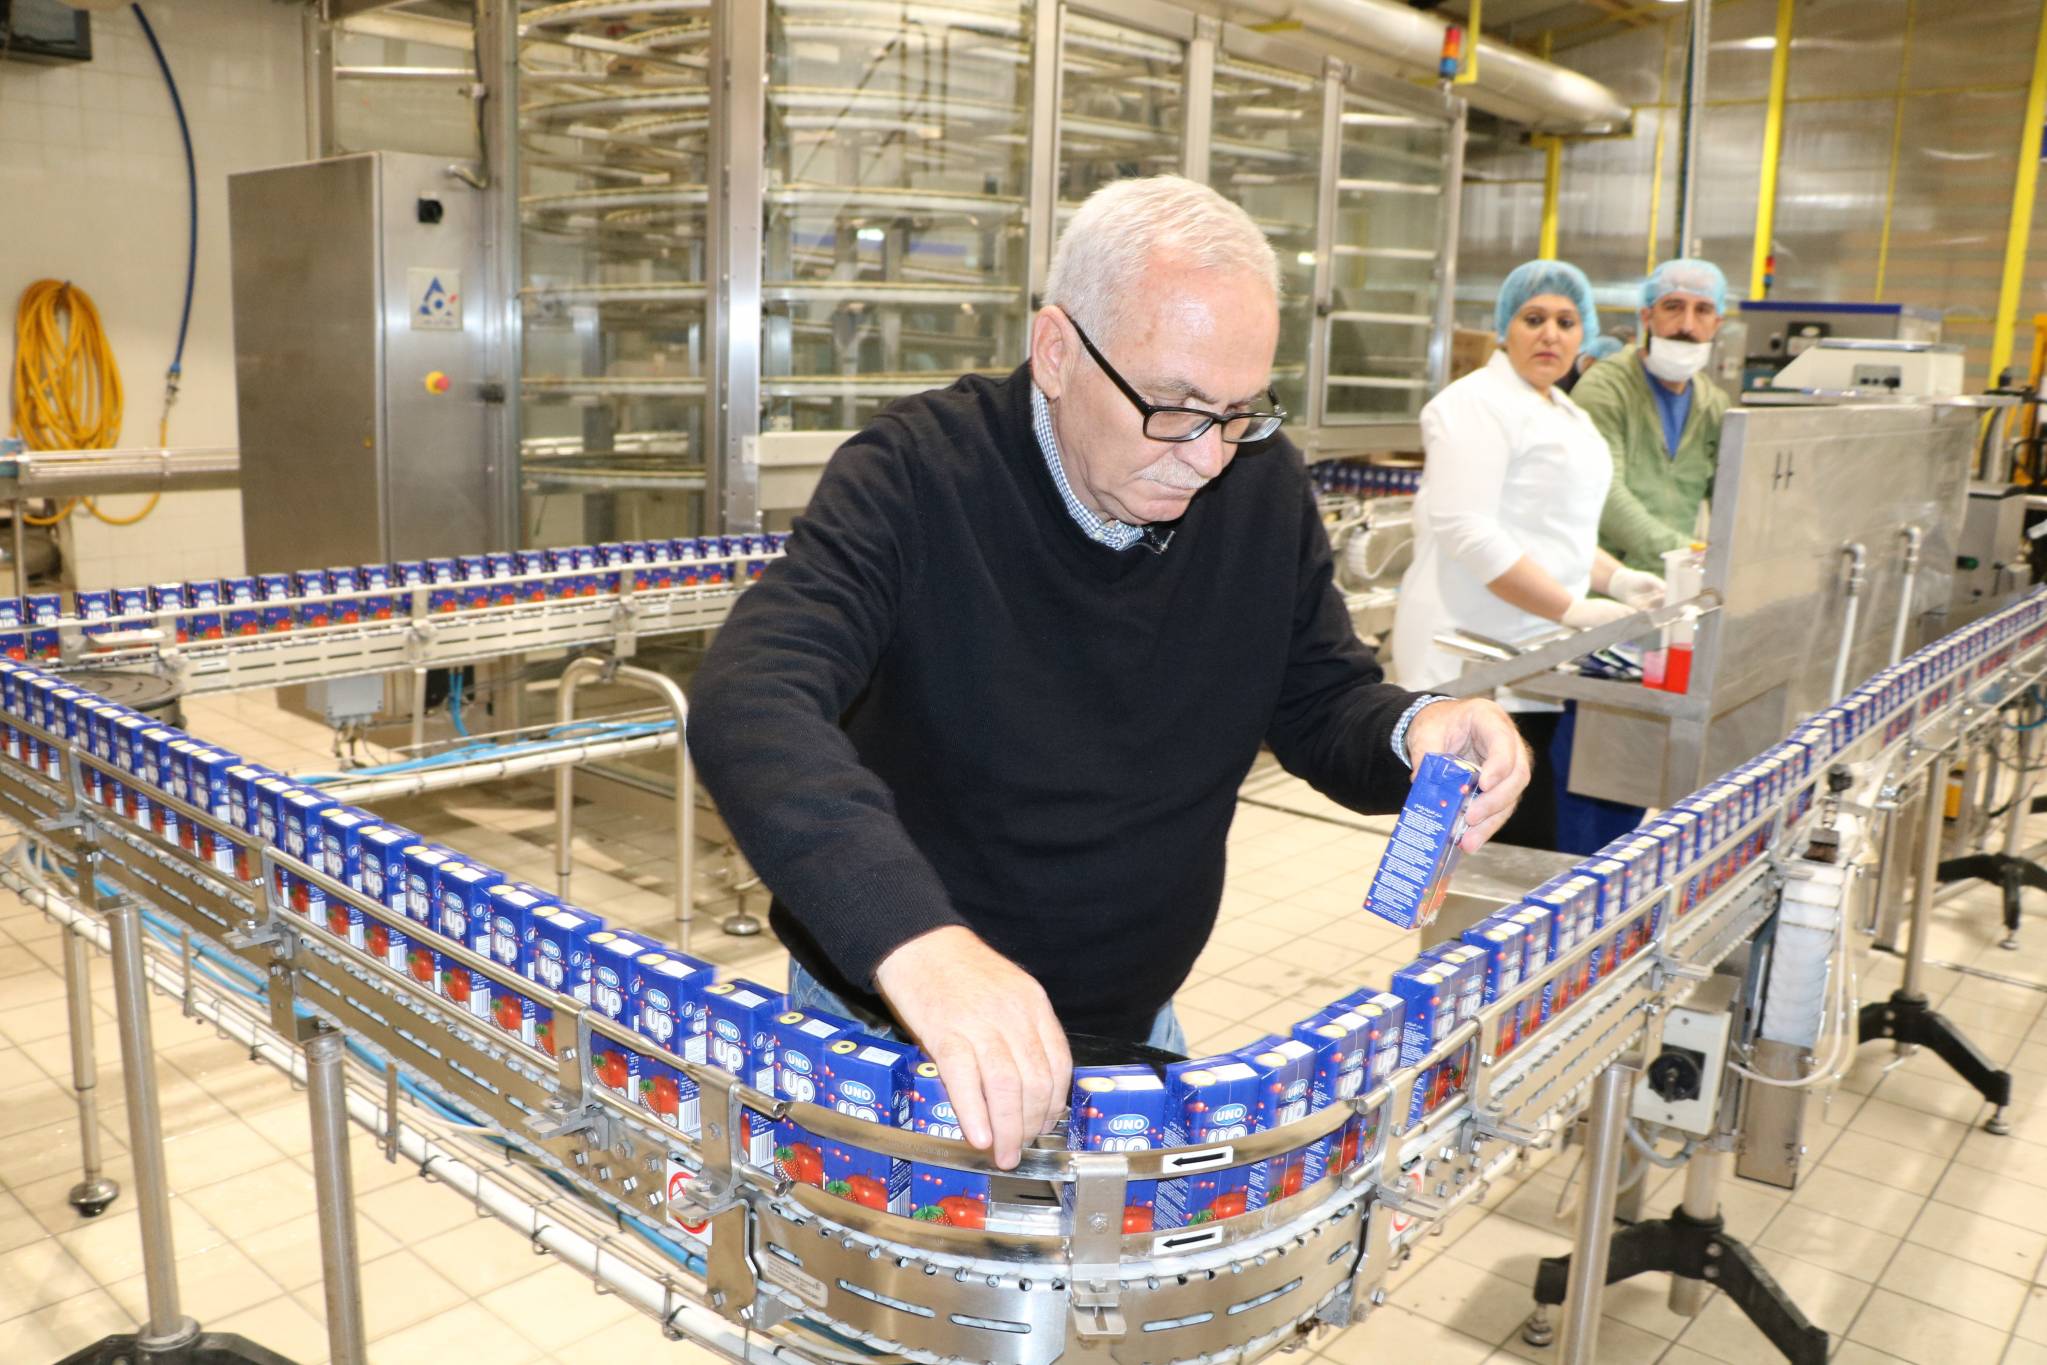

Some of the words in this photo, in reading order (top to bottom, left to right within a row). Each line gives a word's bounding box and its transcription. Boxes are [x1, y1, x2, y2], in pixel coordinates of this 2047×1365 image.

[649, 991, 668, 1008] UNO
[717, 1022, 738, 1038] UNO
[788, 1053, 809, 1070] UNO
[843, 1083, 871, 1101] UNO
[936, 1106, 957, 1119] UN
[1216, 1106, 1244, 1121] UNO
[1113, 1118, 1145, 1130] UNO
